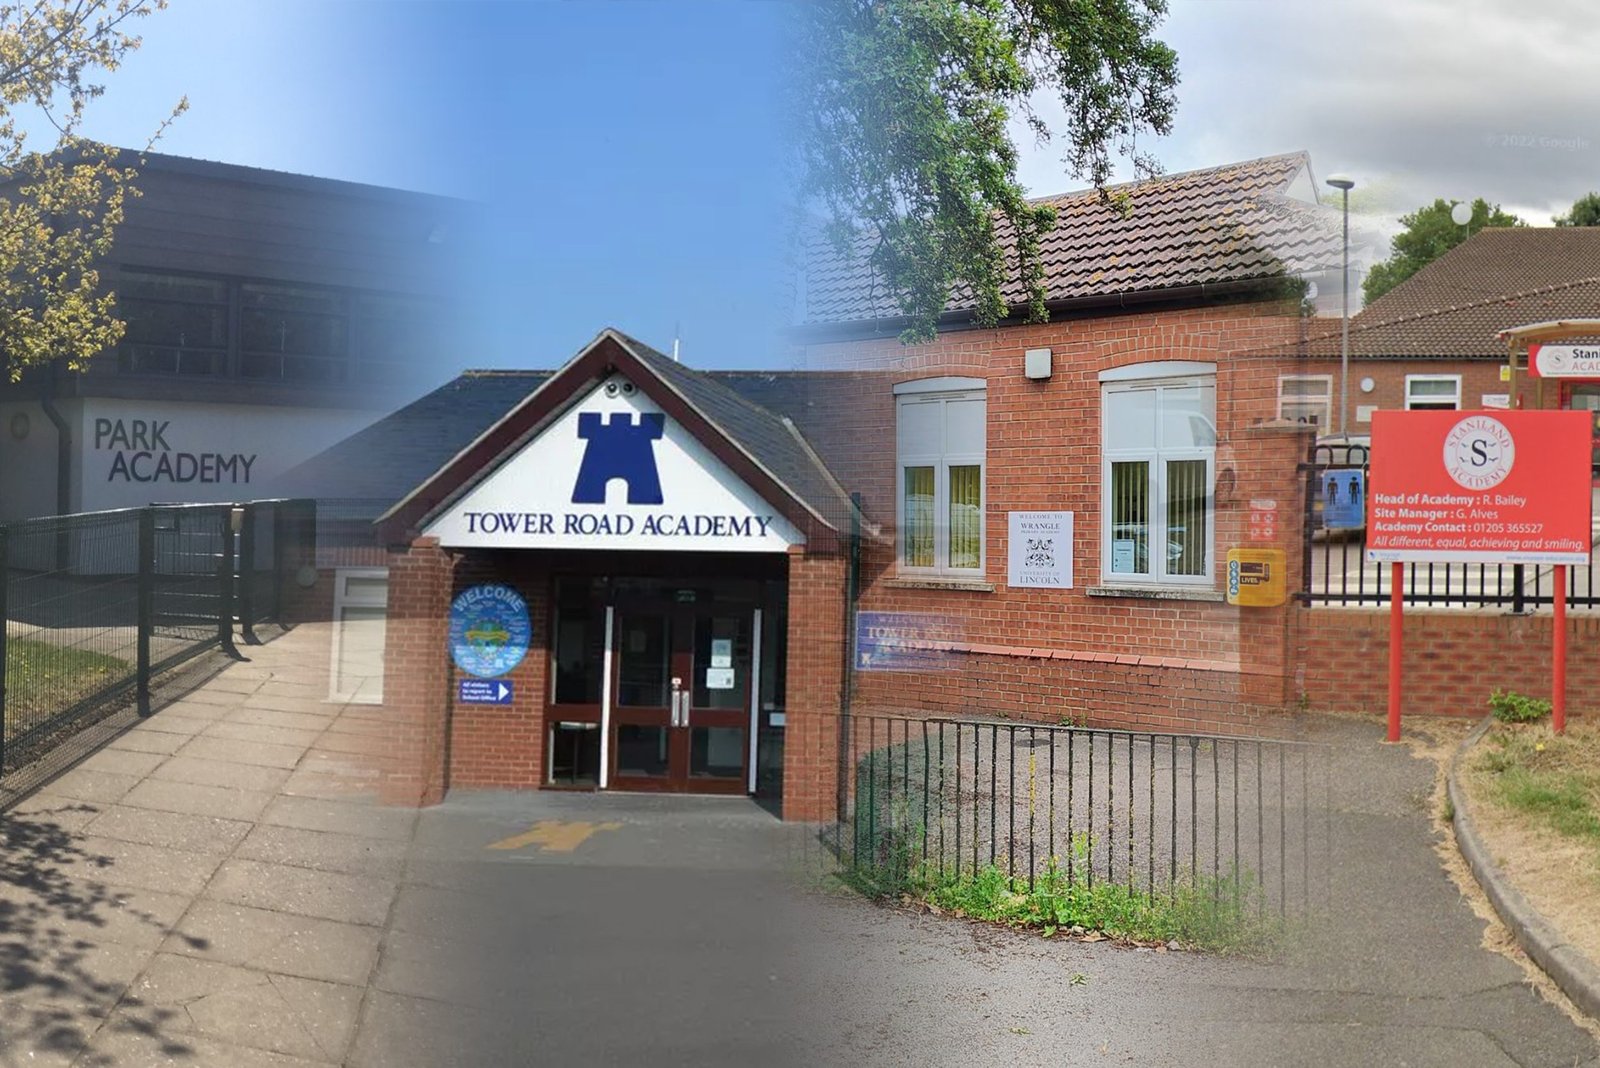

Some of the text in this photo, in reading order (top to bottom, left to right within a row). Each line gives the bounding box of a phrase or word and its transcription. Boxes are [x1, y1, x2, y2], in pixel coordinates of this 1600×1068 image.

[95, 418, 171, 451] PARK
[1449, 419, 1510, 448] STANILAND
[1471, 439, 1487, 467] S
[108, 450, 257, 484] ACADEMY
[1451, 466, 1507, 487] ACADEMY
[1375, 493, 1404, 504] Head
[1407, 493, 1420, 504] of
[1422, 494, 1474, 507] Academy
[1483, 495, 1493, 505] R.
[1495, 495, 1526, 507] Bailey
[463, 512, 774, 537] TOWER ROAD ACADEMY
[1375, 508, 1396, 518] Site
[1398, 508, 1448, 520] Manager
[1456, 509, 1468, 519] G.
[1470, 509, 1498, 519] Alves
[1375, 522, 1422, 533] Academy
[1424, 522, 1466, 532] Contact
[1473, 523, 1504, 533] 01205
[1506, 523, 1543, 533] 365527
[1374, 536, 1585, 551] All different, equal, achieving and smiling.
[1020, 575, 1060, 584] LINCOLN
[454, 586, 525, 612] WELCOME
